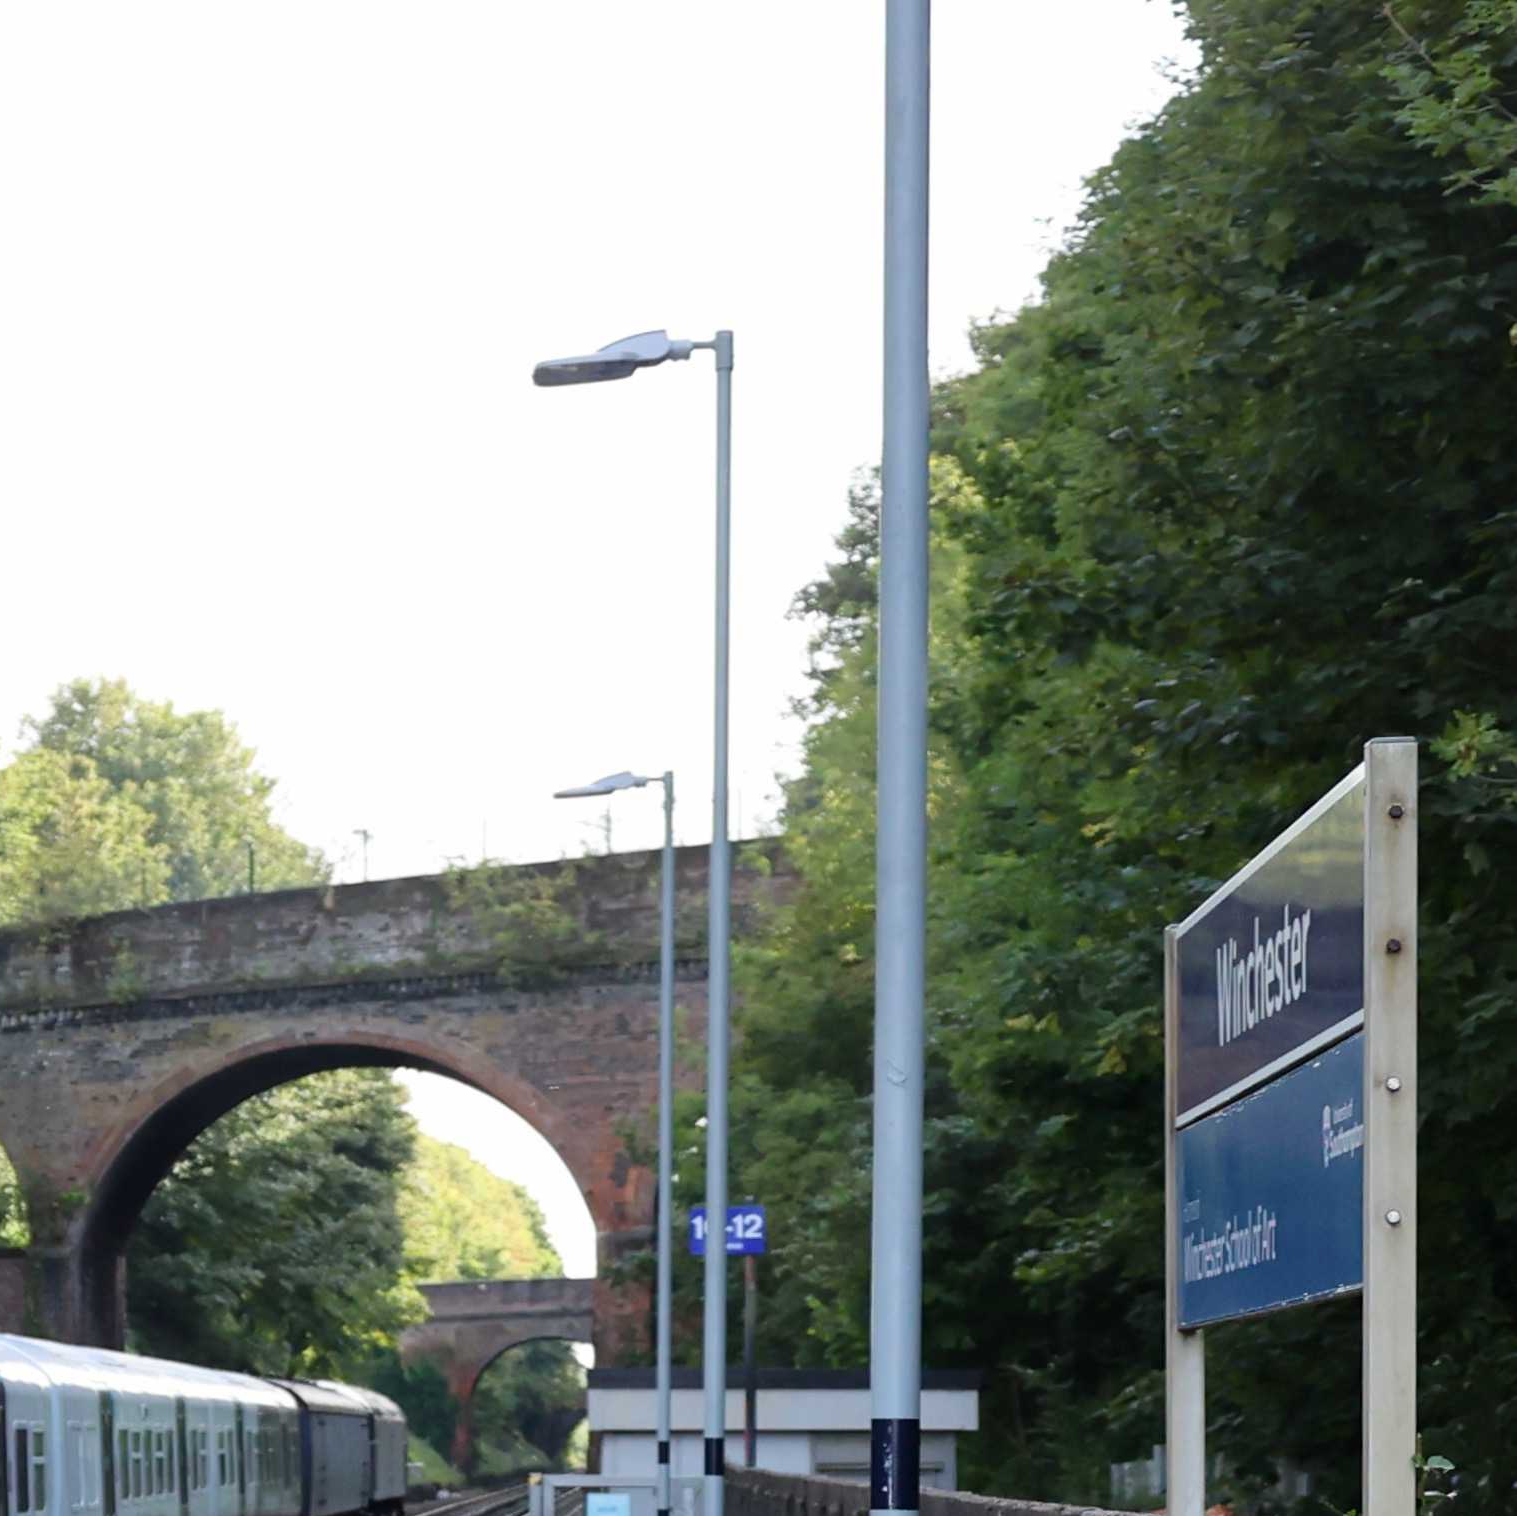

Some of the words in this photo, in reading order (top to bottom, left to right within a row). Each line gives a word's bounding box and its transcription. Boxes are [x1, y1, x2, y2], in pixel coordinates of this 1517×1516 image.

[1216, 903, 1312, 1048] Winchester
[691, 1213, 763, 1240] 1-12
[1183, 1227, 1225, 1284] Winchester
[1225, 1210, 1252, 1273] School
[1262, 1208, 1277, 1260] Art
